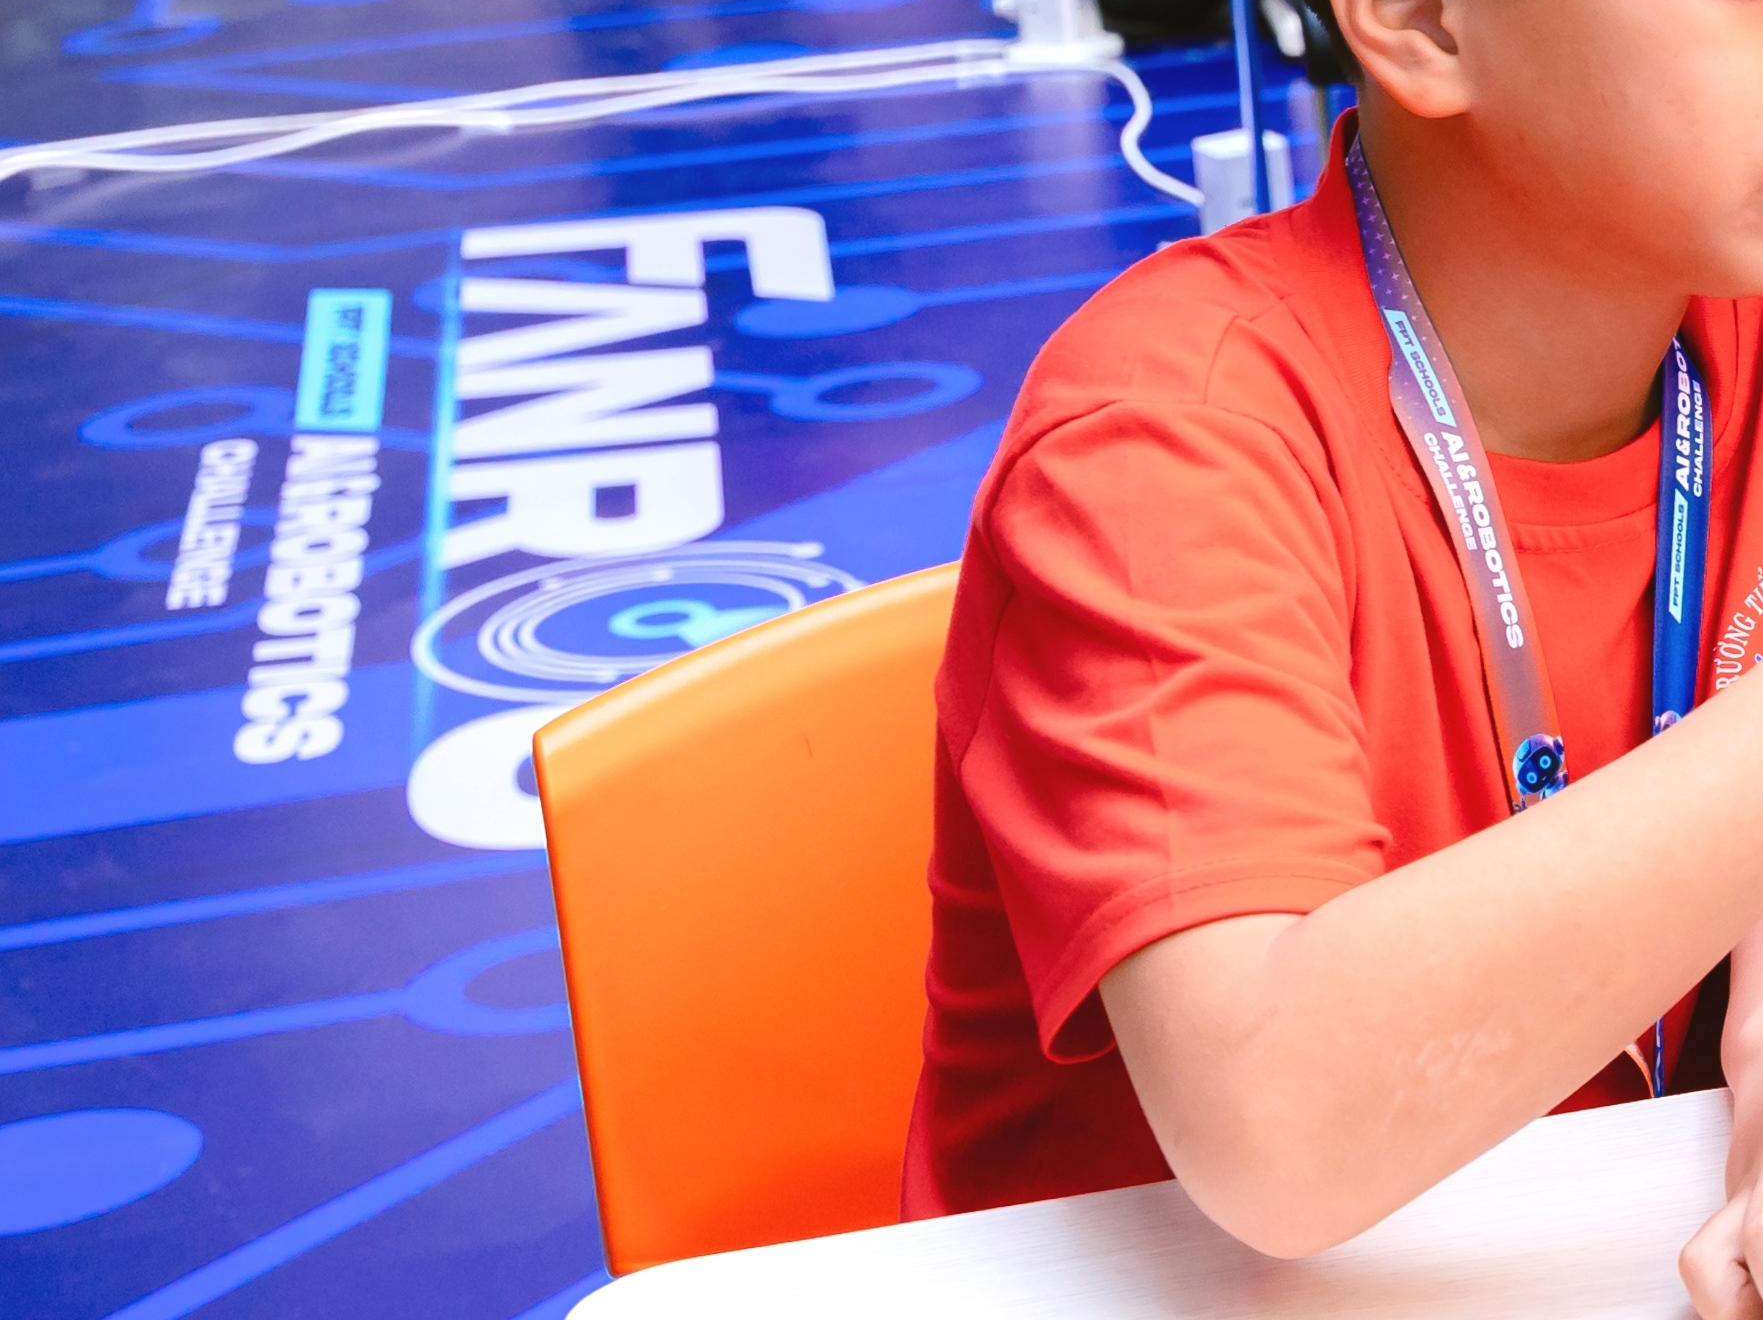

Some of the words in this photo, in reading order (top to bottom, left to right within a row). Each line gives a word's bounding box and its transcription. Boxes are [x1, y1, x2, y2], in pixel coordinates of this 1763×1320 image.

[1394, 320, 1413, 347] FPT
[1410, 350, 1446, 417] SCHOOLS
[1692, 379, 1703, 498] CHALLENGE
[1424, 432, 1477, 551] CHALLENGE
[1675, 504, 1685, 573] SCHOOLS
[1673, 577, 1681, 607] FPT
[1713, 612, 1756, 690] RƯỜNG
